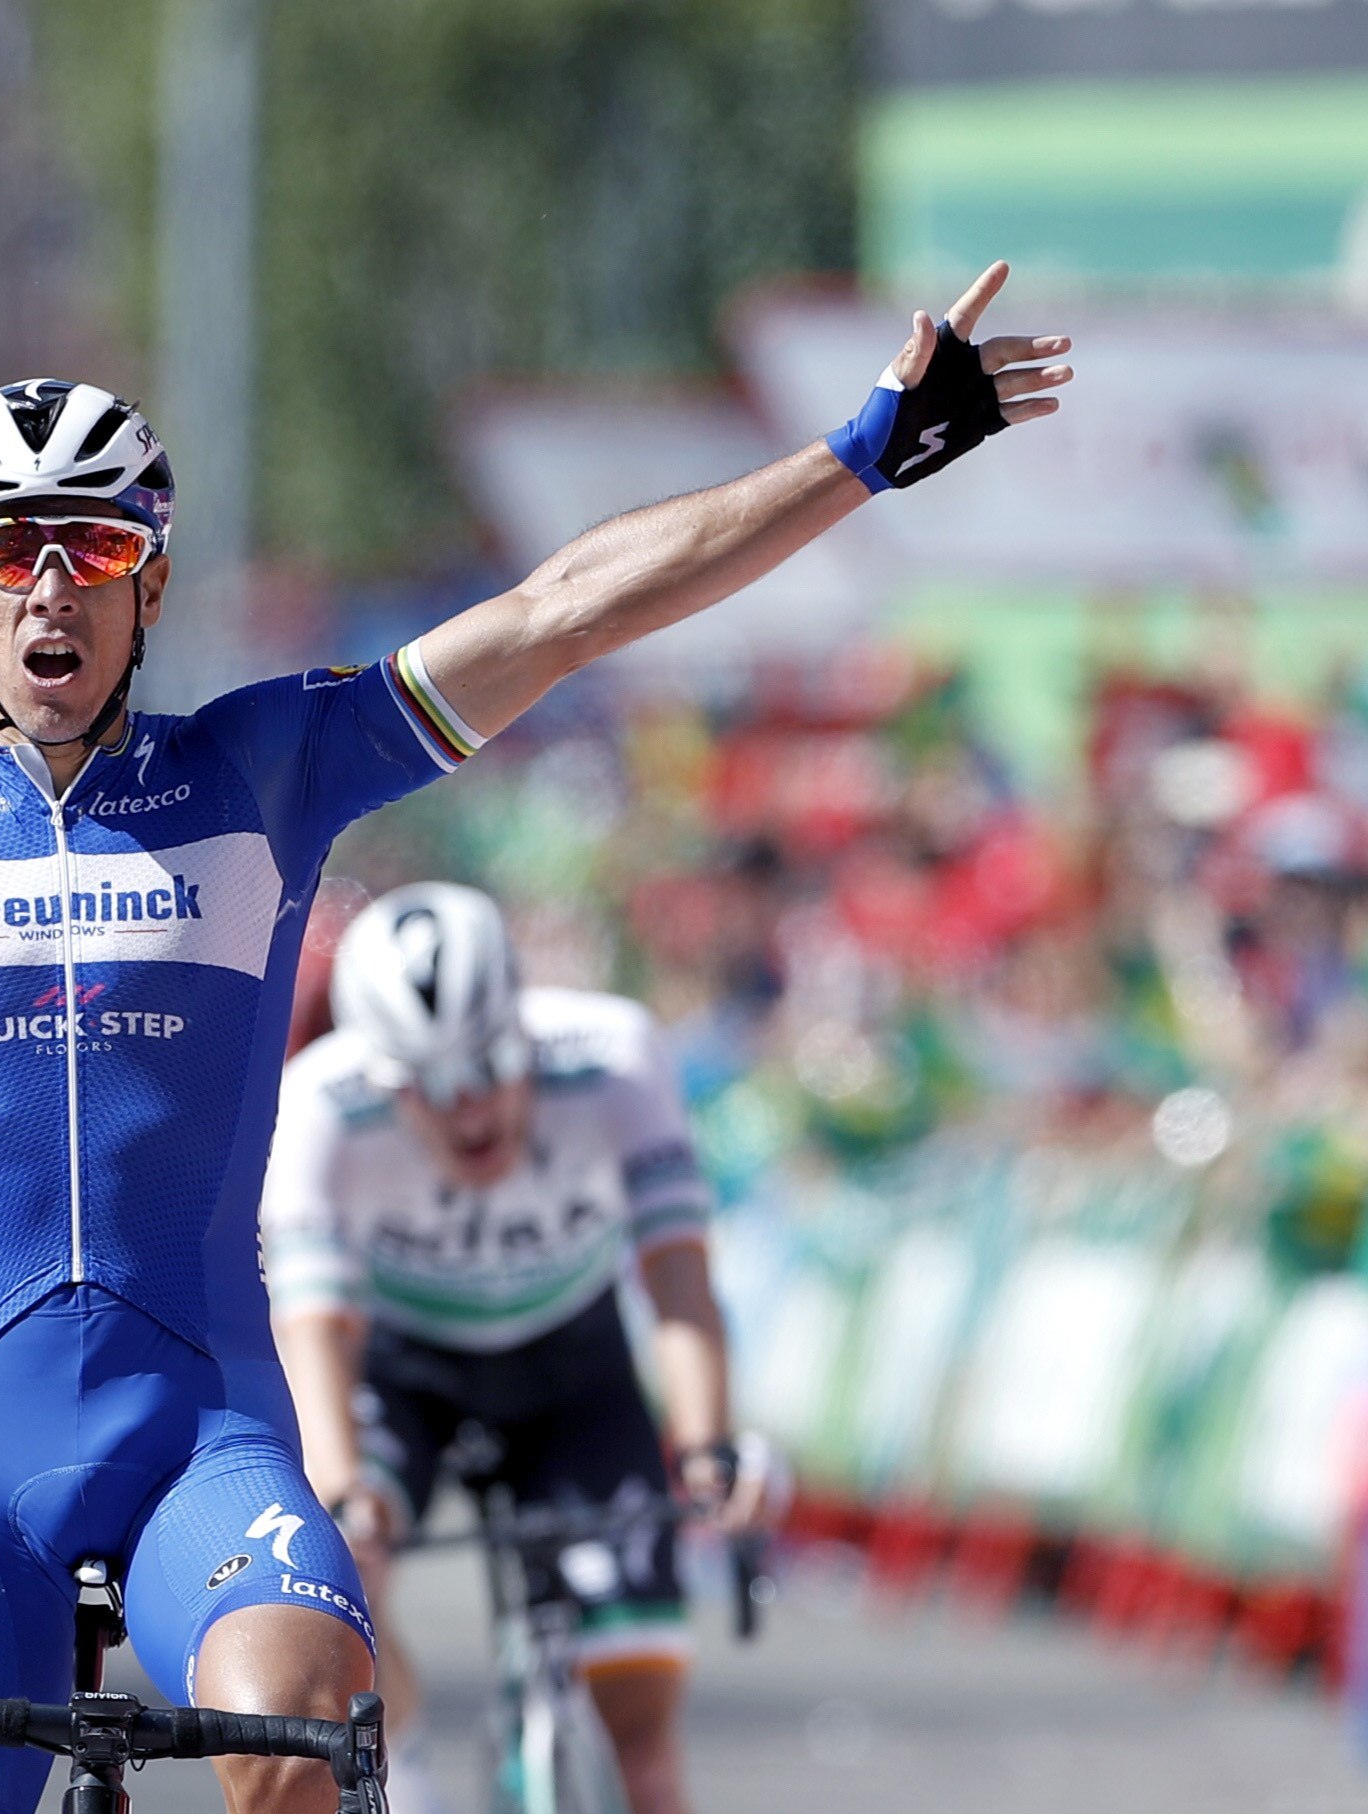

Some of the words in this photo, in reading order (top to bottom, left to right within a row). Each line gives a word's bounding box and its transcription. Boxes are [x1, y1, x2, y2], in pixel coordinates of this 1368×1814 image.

[88, 783, 191, 816] latexco
[19, 925, 106, 941] WINDOWS
[100, 1011, 184, 1039] STEP
[35, 1040, 113, 1056] FLOORS
